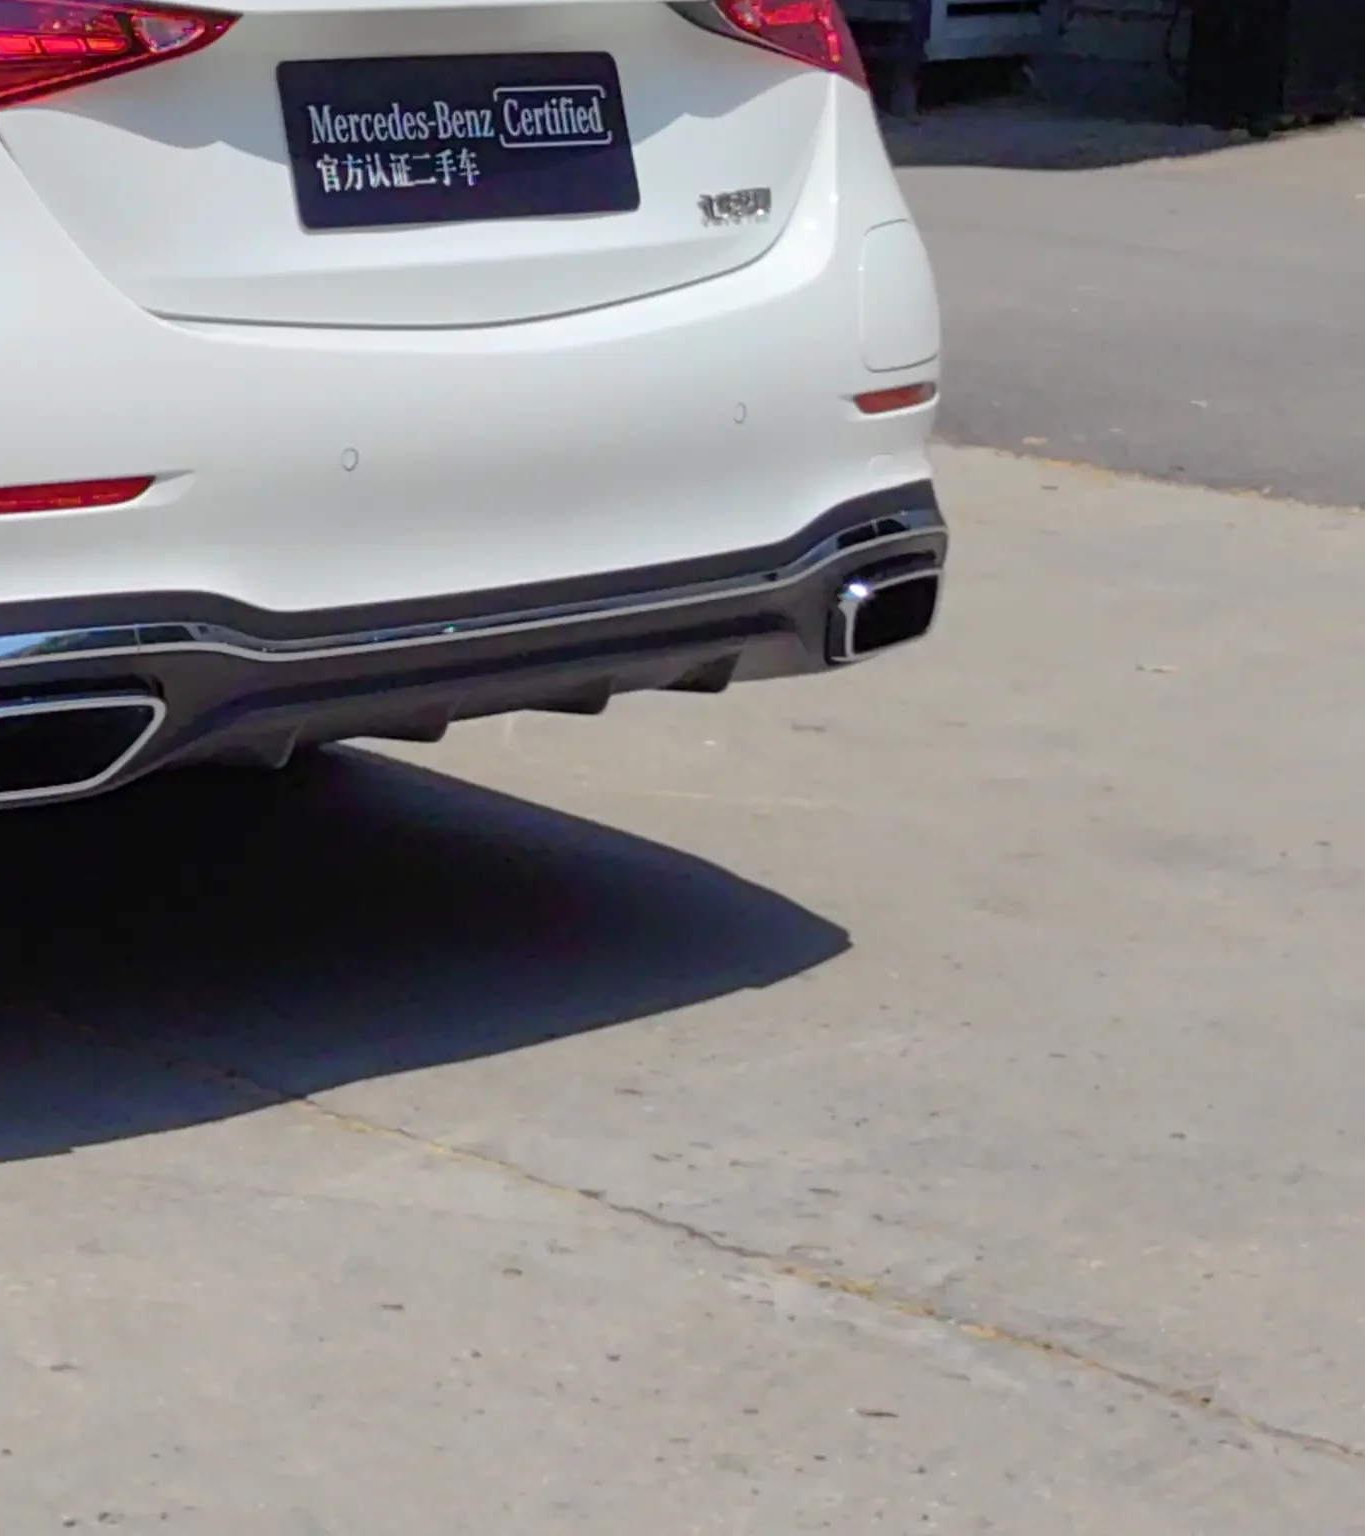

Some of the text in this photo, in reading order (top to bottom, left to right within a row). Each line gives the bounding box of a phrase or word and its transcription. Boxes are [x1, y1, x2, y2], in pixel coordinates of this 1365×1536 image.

[306, 96, 604, 144] Mercedes-Benz Certified
[316, 148, 481, 193] 官方认证二手车
